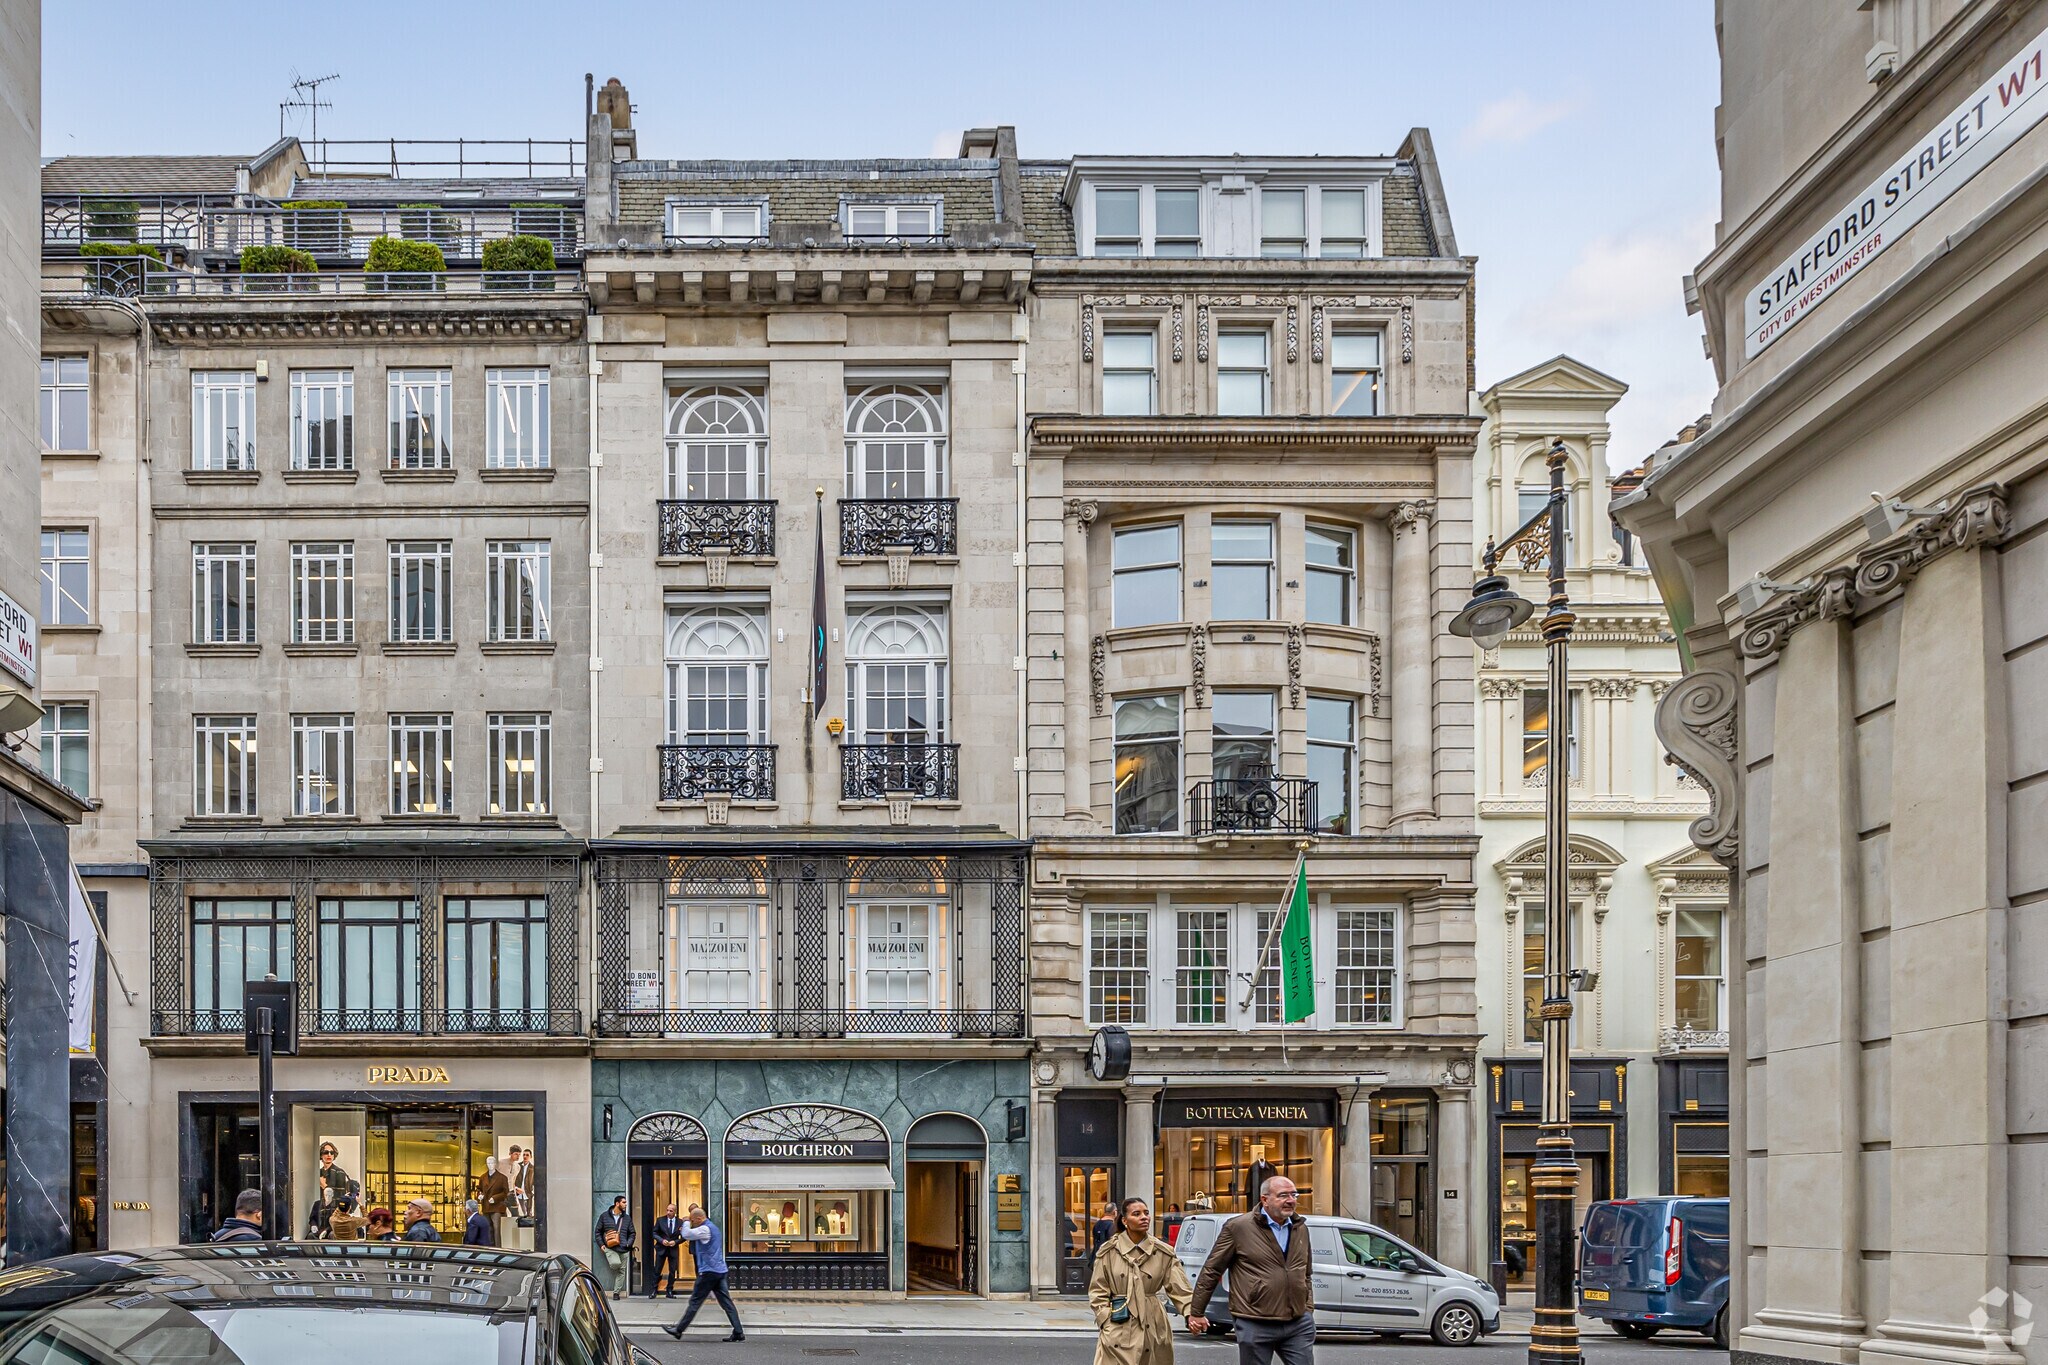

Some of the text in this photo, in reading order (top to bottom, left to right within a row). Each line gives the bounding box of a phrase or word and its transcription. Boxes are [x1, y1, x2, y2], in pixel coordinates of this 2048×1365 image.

[1759, 49, 2042, 316] STAFFORD STREET W1
[1759, 233, 1882, 344] CITY OF WESTMINSTER
[18, 634, 33, 661] W1
[690, 943, 746, 953] MAZZOLENI
[868, 943, 924, 953] MAZZOLENI
[69, 938, 80, 1025] RADA
[637, 972, 657, 980] BOND
[1290, 950, 1299, 1000] VENETA
[368, 1067, 450, 1083] PRADA
[1186, 1106, 1308, 1119] BOTTEGA VENETA
[1081, 1123, 1093, 1134] 14
[662, 1145, 673, 1156] 15
[761, 1144, 854, 1157] BOUCHERON
[113, 1201, 151, 1211] PRADA
